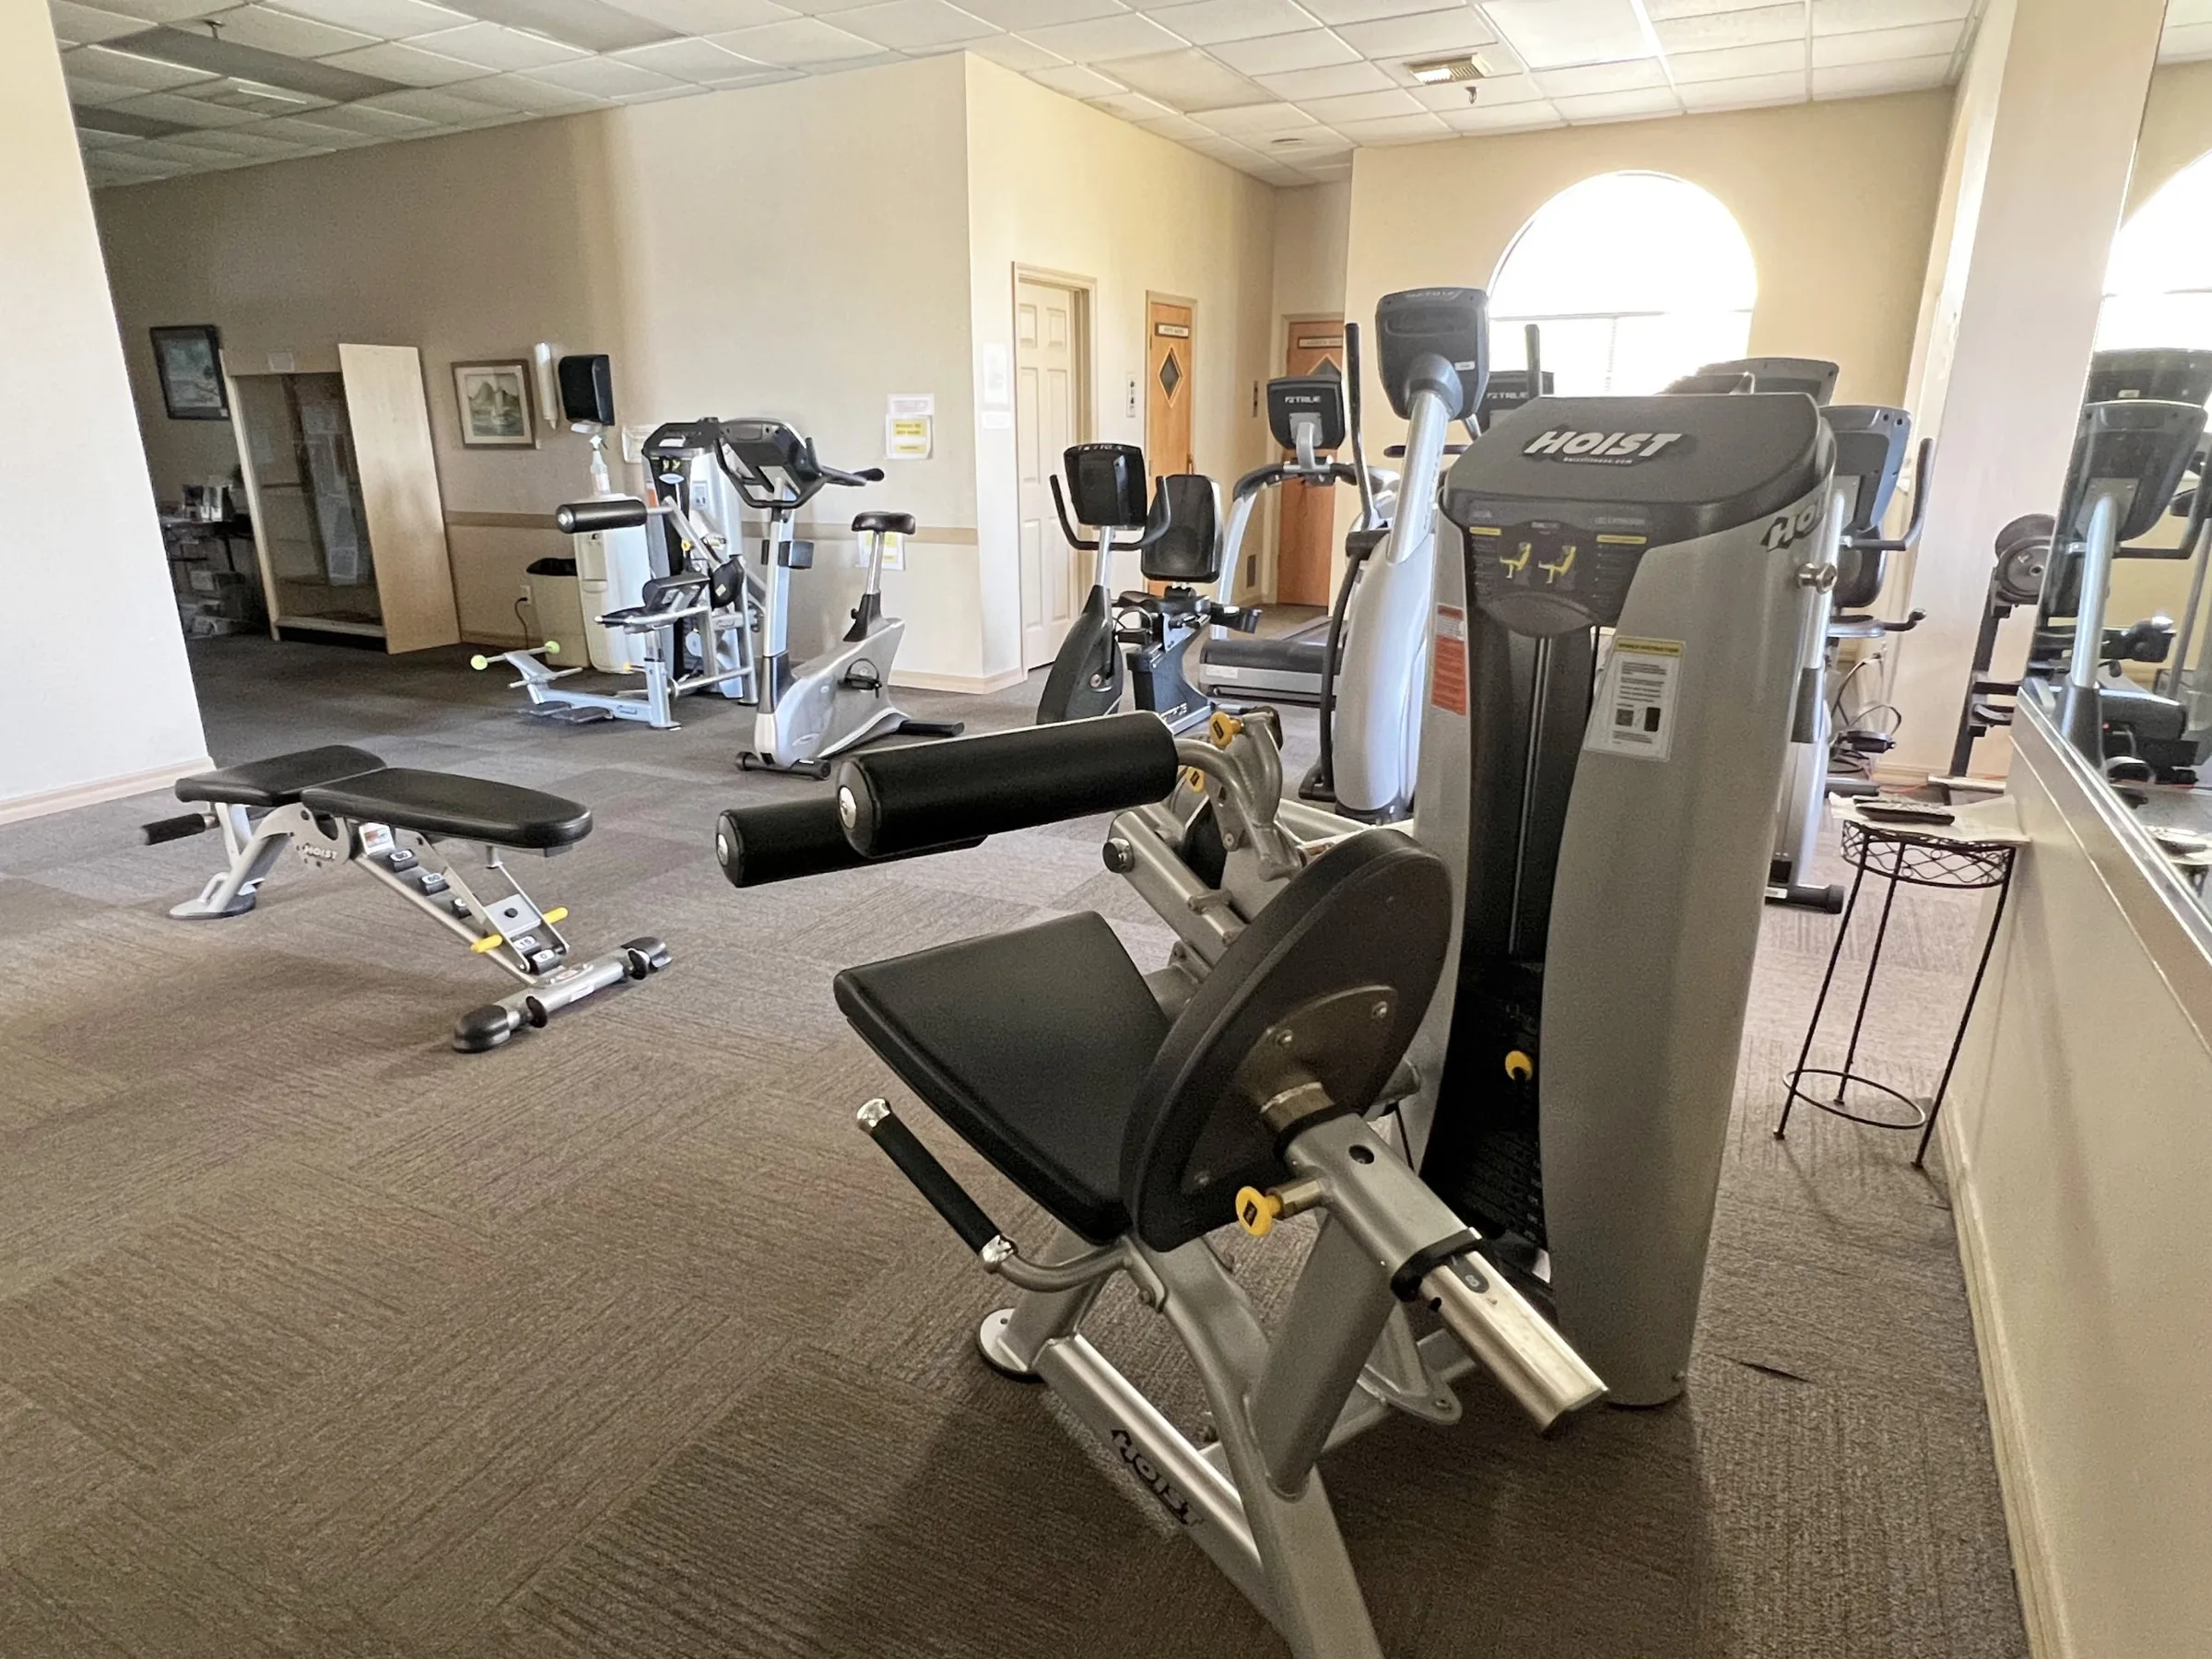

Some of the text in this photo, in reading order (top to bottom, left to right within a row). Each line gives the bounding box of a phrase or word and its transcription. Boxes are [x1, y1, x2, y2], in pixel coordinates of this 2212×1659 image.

[1523, 430, 1683, 457] HOIST
[303, 844, 338, 860] HOIST
[1111, 1430, 1203, 1525] HOIST
